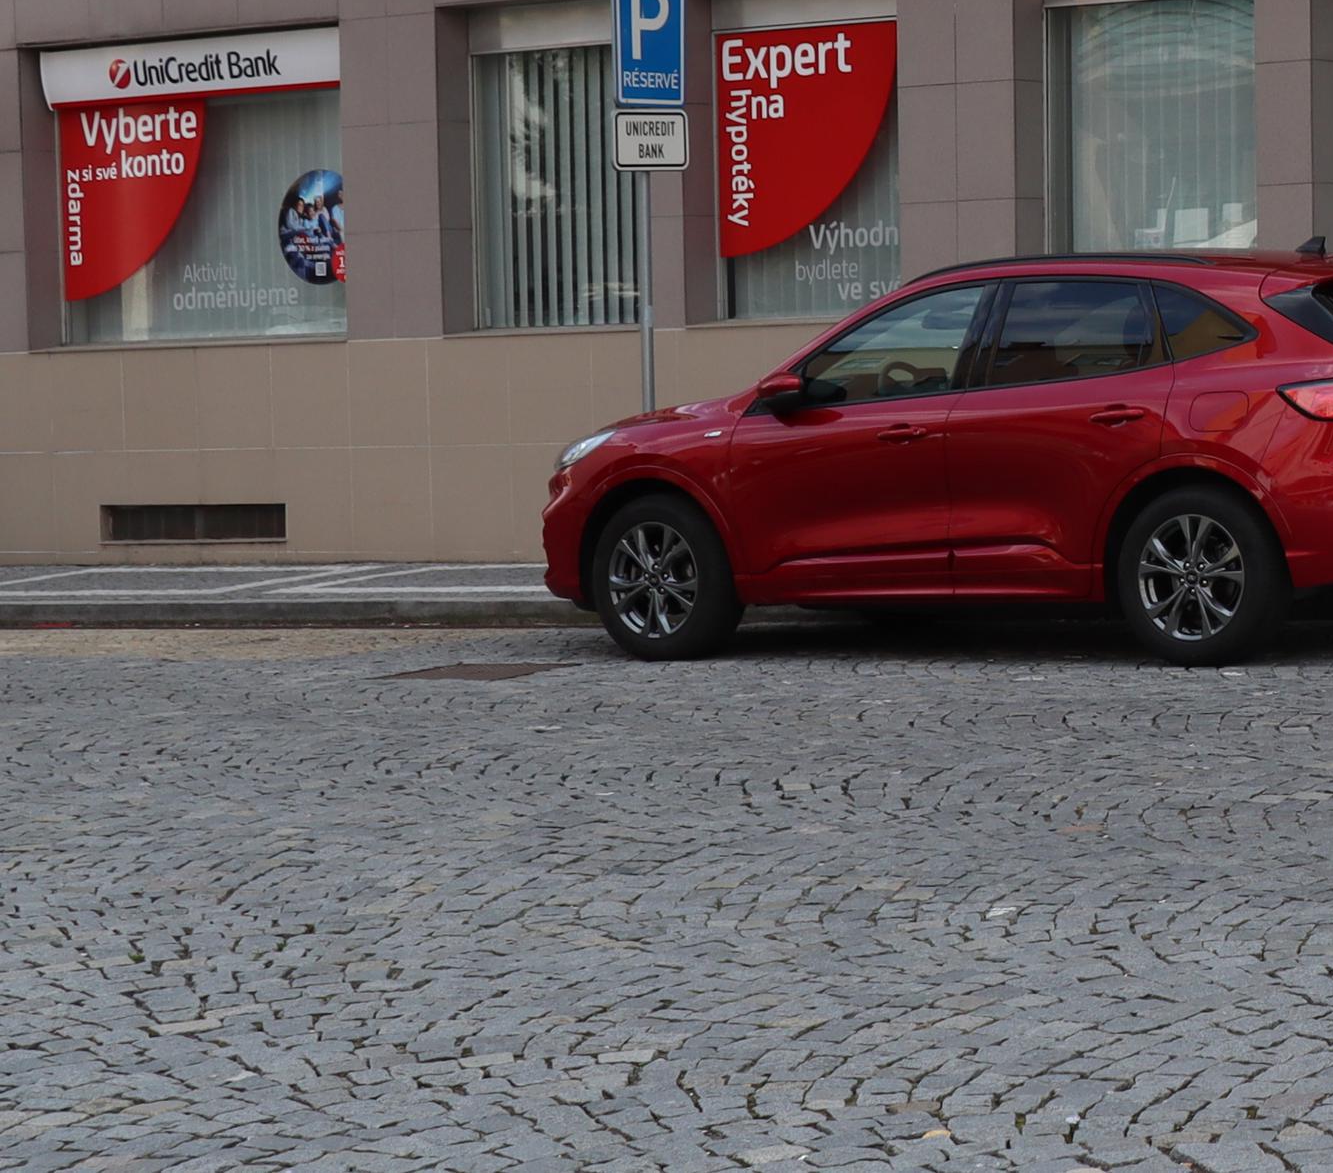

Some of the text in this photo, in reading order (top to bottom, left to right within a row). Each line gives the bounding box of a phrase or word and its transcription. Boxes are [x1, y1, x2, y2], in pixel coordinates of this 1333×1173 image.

[134, 48, 281, 86] UniCredit Bank
[722, 33, 852, 89] Expert
[623, 67, 679, 89] RÉSERVÉ
[751, 94, 785, 119] na
[80, 106, 197, 155] Vyberte
[625, 121, 675, 136] UNICREDIT
[82, 149, 185, 182] si své konto
[638, 144, 665, 159] BANK
[725, 89, 755, 227] hypotéky
[808, 220, 899, 255] Výhodn
[183, 262, 239, 287] Aktivity
[795, 259, 858, 285] bydlete
[173, 282, 298, 312] odměňujeme
[837, 282, 862, 300] ve
